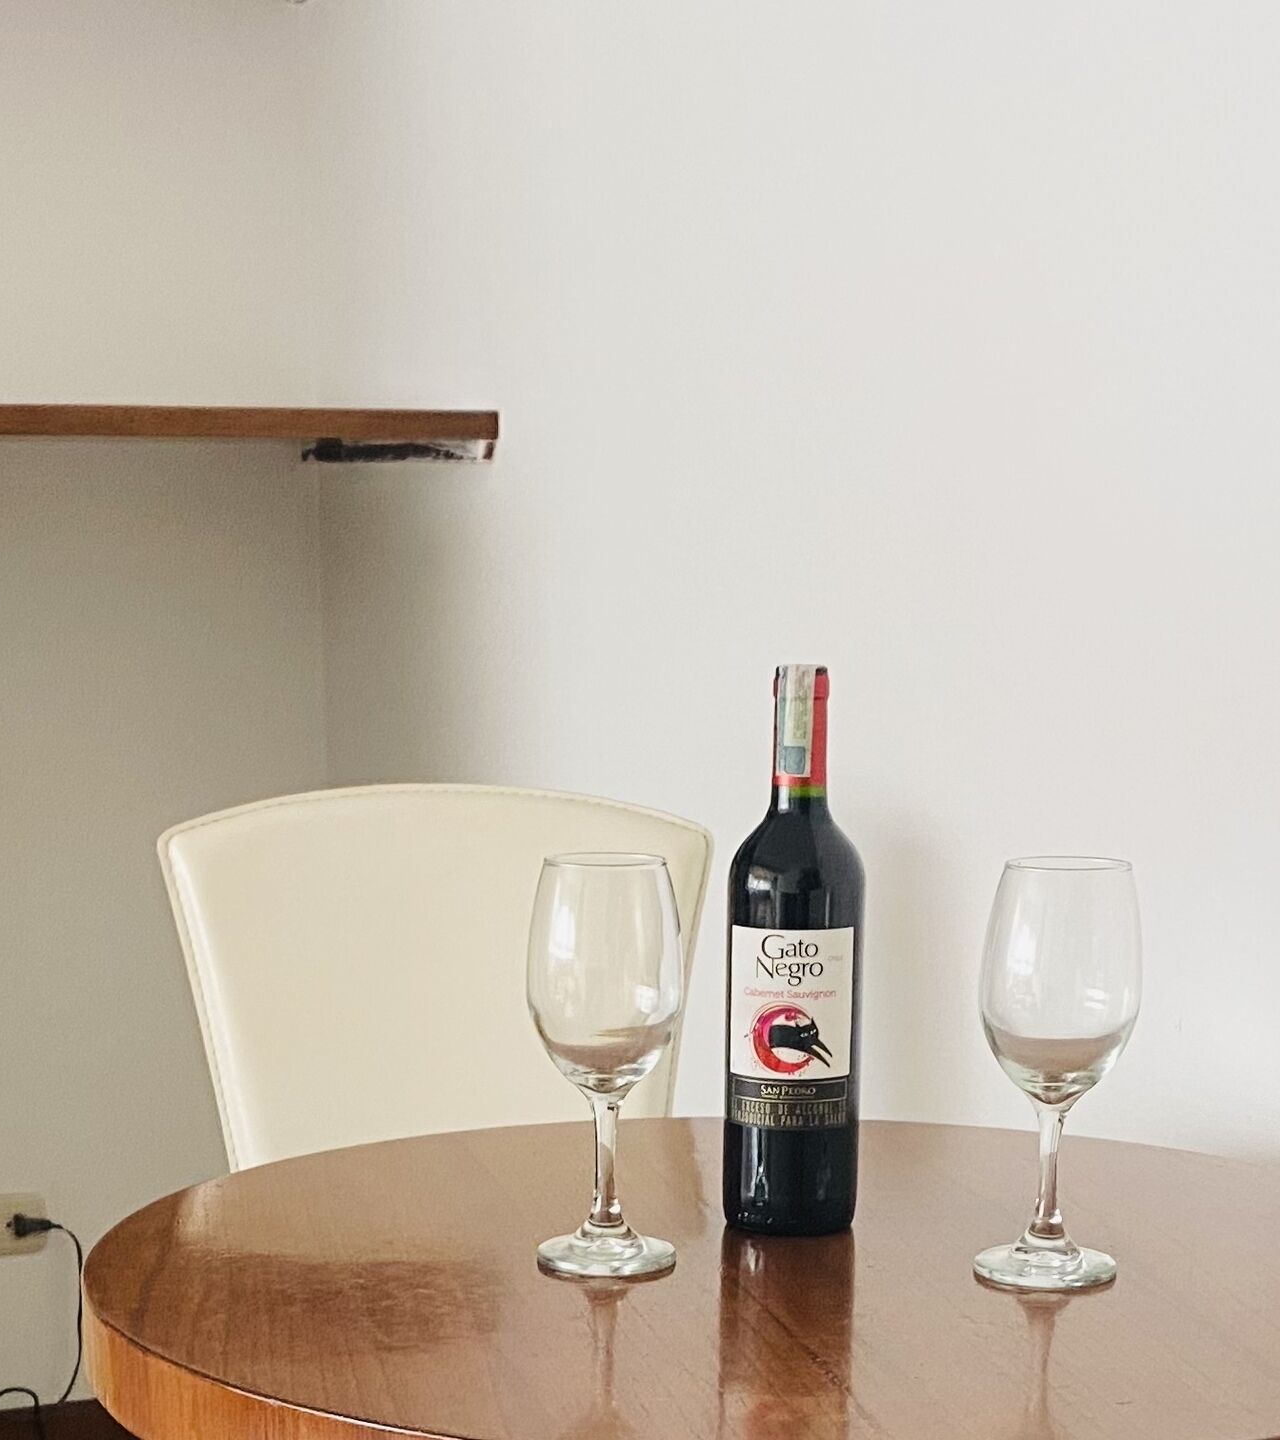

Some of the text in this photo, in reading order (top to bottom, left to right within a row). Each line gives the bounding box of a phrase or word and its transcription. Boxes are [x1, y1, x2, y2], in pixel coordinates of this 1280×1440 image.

[761, 934, 819, 960] Gato
[756, 956, 824, 987] Negro
[743, 986, 837, 1001] Cabernet Sauvignon
[760, 1084, 817, 1096] SAN PEDRO
[741, 1099, 771, 1114] EXCESO
